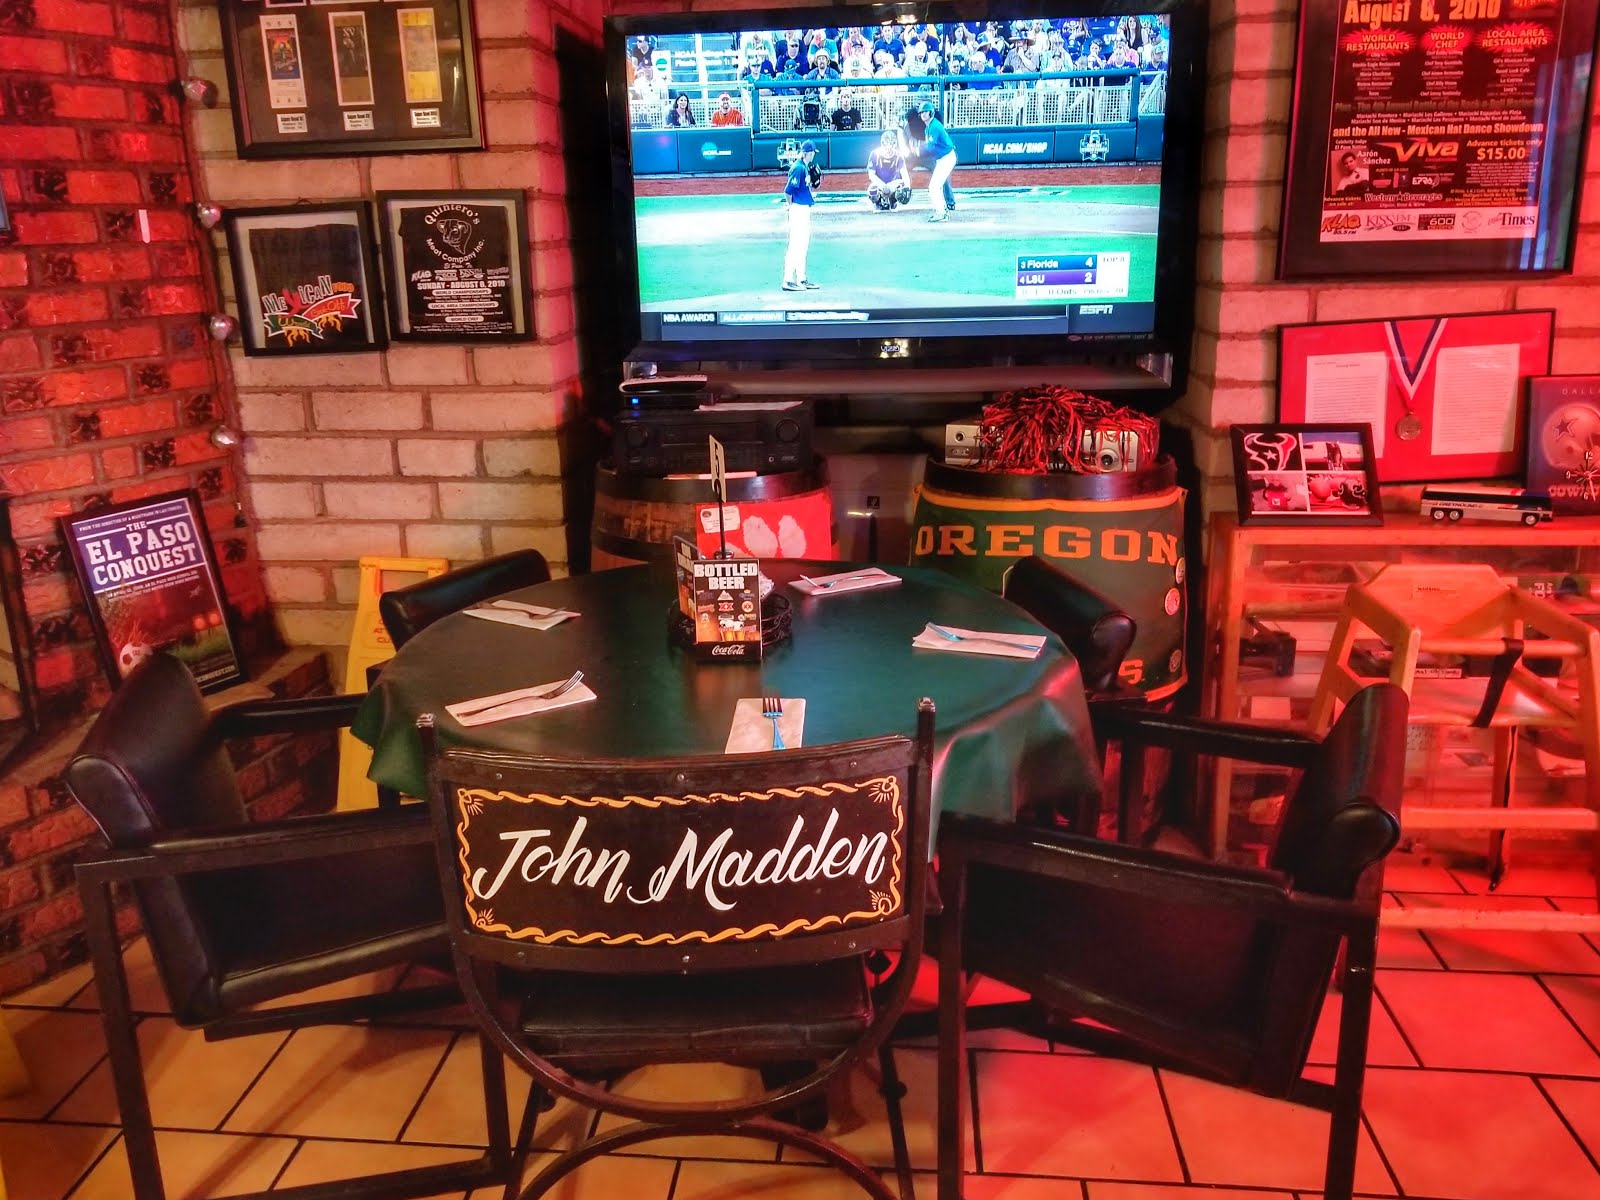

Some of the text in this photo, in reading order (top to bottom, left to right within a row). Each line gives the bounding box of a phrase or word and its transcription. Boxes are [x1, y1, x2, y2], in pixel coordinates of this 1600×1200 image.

[1344, 0, 1410, 29] August
[1449, 0, 1501, 19] 2010
[1362, 34, 1396, 42] WORLD
[1430, 32, 1465, 40] WORLD
[1487, 28, 1545, 38] LOCAL AREA
[1346, 42, 1410, 51] RESTAURANTS
[1435, 40, 1459, 48] CHEF
[1482, 37, 1548, 47] RESTAURANTS
[1333, 122, 1544, 137] and the All New Mexican Hat Dance Showdown
[1525, 139, 1543, 148] only
[1356, 149, 1378, 157] Aarón
[1477, 147, 1526, 160] $15.00
[1362, 157, 1391, 165] Sánchez
[424, 204, 481, 225] Quintero's
[1499, 212, 1536, 226] Times
[1429, 217, 1454, 226] 600
[426, 238, 485, 263] Meat Company Inc.
[1027, 259, 1059, 269] Florida
[1084, 257, 1094, 267] 4
[1026, 274, 1045, 284] LSU
[1084, 272, 1092, 283] 2
[417, 282, 446, 290] SUNDAY
[451, 281, 479, 289] AUGUST
[487, 280, 506, 288] 2010
[1080, 304, 1113, 314] ESPN
[663, 312, 715, 322] NBA AWARDS
[126, 520, 147, 532] THE
[85, 521, 191, 565] EL PASO
[915, 524, 1178, 566] OREGON
[92, 542, 197, 586] CONQUEST
[693, 562, 758, 578] BOTTLED
[708, 576, 745, 590] BEER
[471, 807, 888, 911] John Madden
